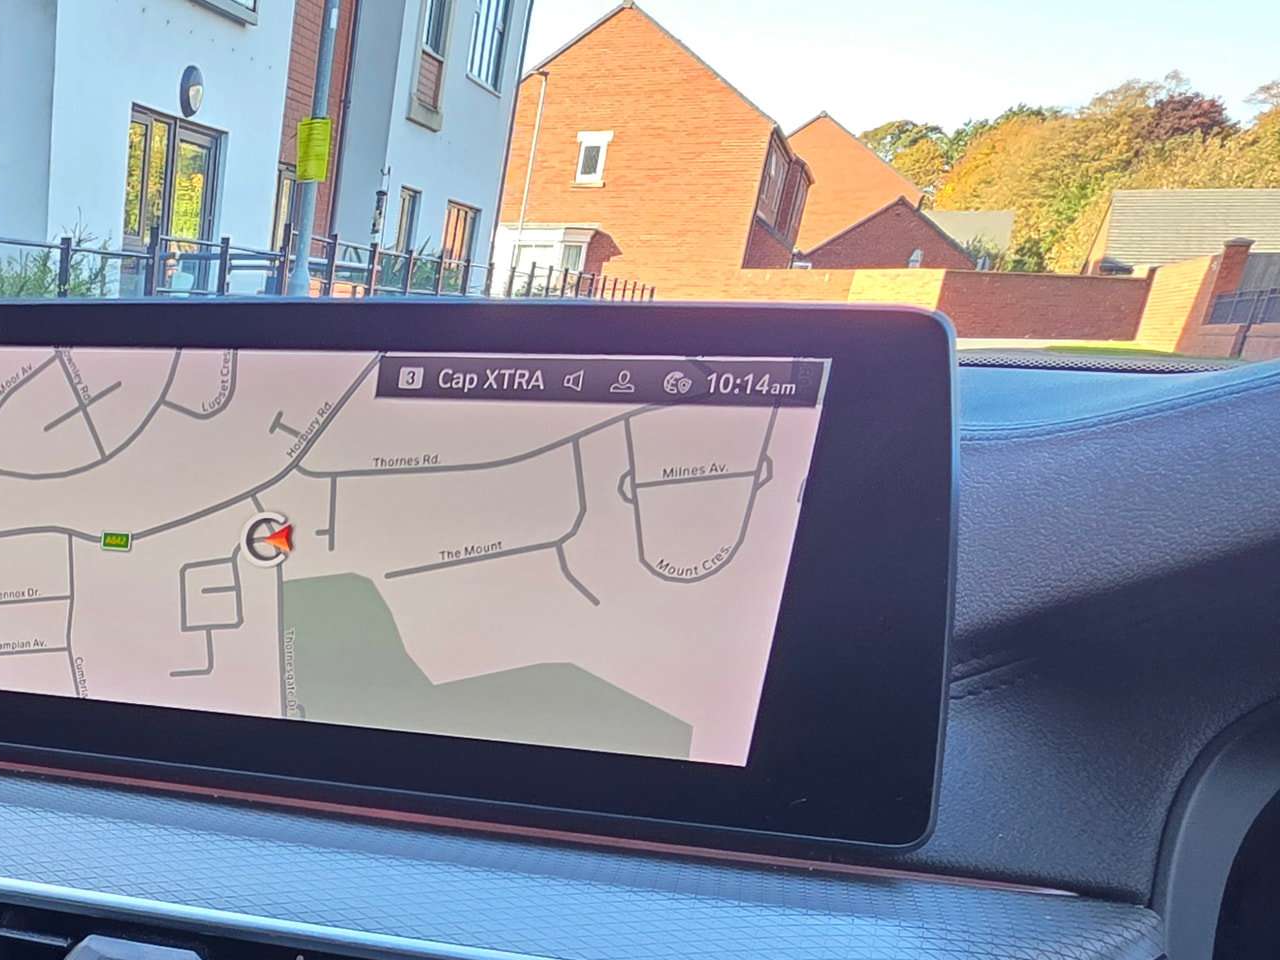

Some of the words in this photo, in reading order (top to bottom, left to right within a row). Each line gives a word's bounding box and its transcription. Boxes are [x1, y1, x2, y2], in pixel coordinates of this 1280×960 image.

[438, 368, 478, 392] Cap
[483, 369, 545, 390] XTRA
[286, 417, 319, 459] Horbury
[373, 457, 420, 468] Thornes
[662, 465, 706, 478] Milnes
[439, 549, 461, 560] The
[464, 541, 503, 556] Mount
[656, 558, 699, 577] Mount
